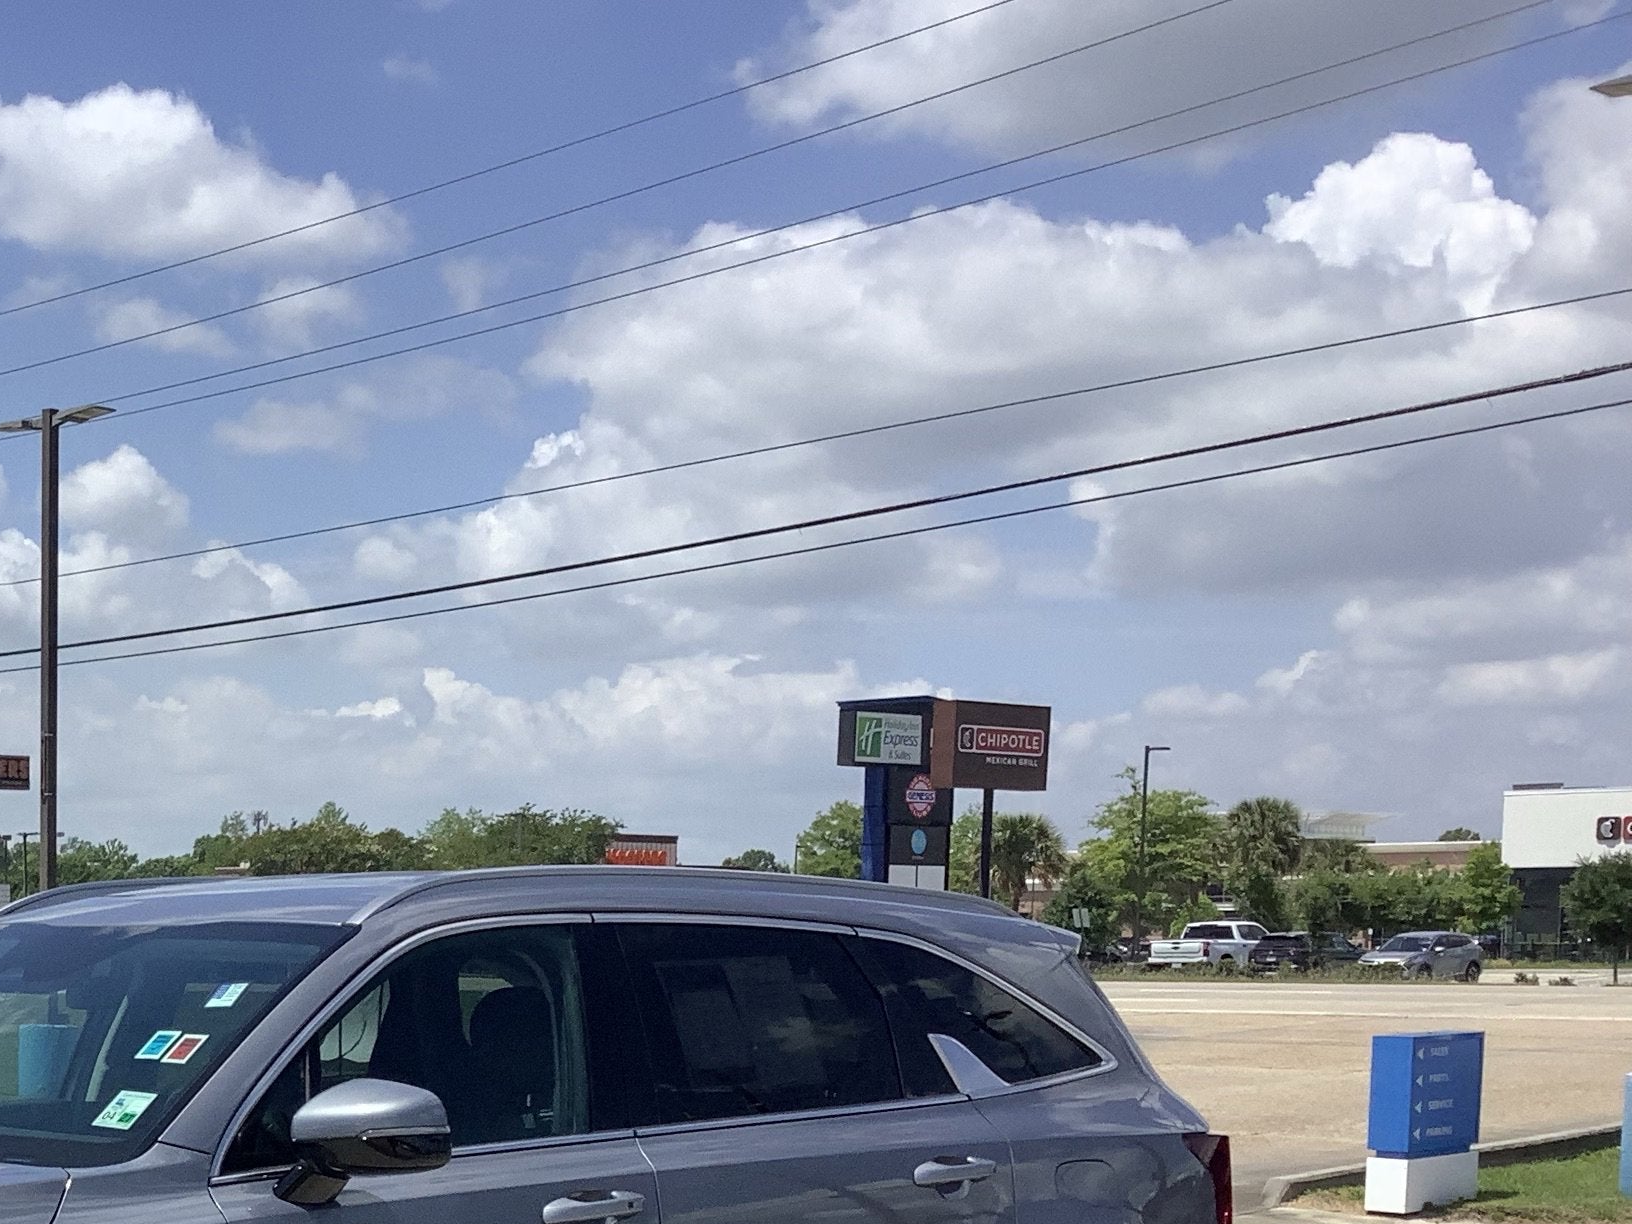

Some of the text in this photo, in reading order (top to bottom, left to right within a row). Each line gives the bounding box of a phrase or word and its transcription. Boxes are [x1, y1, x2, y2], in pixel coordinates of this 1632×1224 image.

[883, 731, 919, 748] Express
[977, 732, 1041, 751] CHIPOTLE
[985, 756, 1039, 768] MEXICAN GRILL
[102, 1111, 118, 1120] 04
